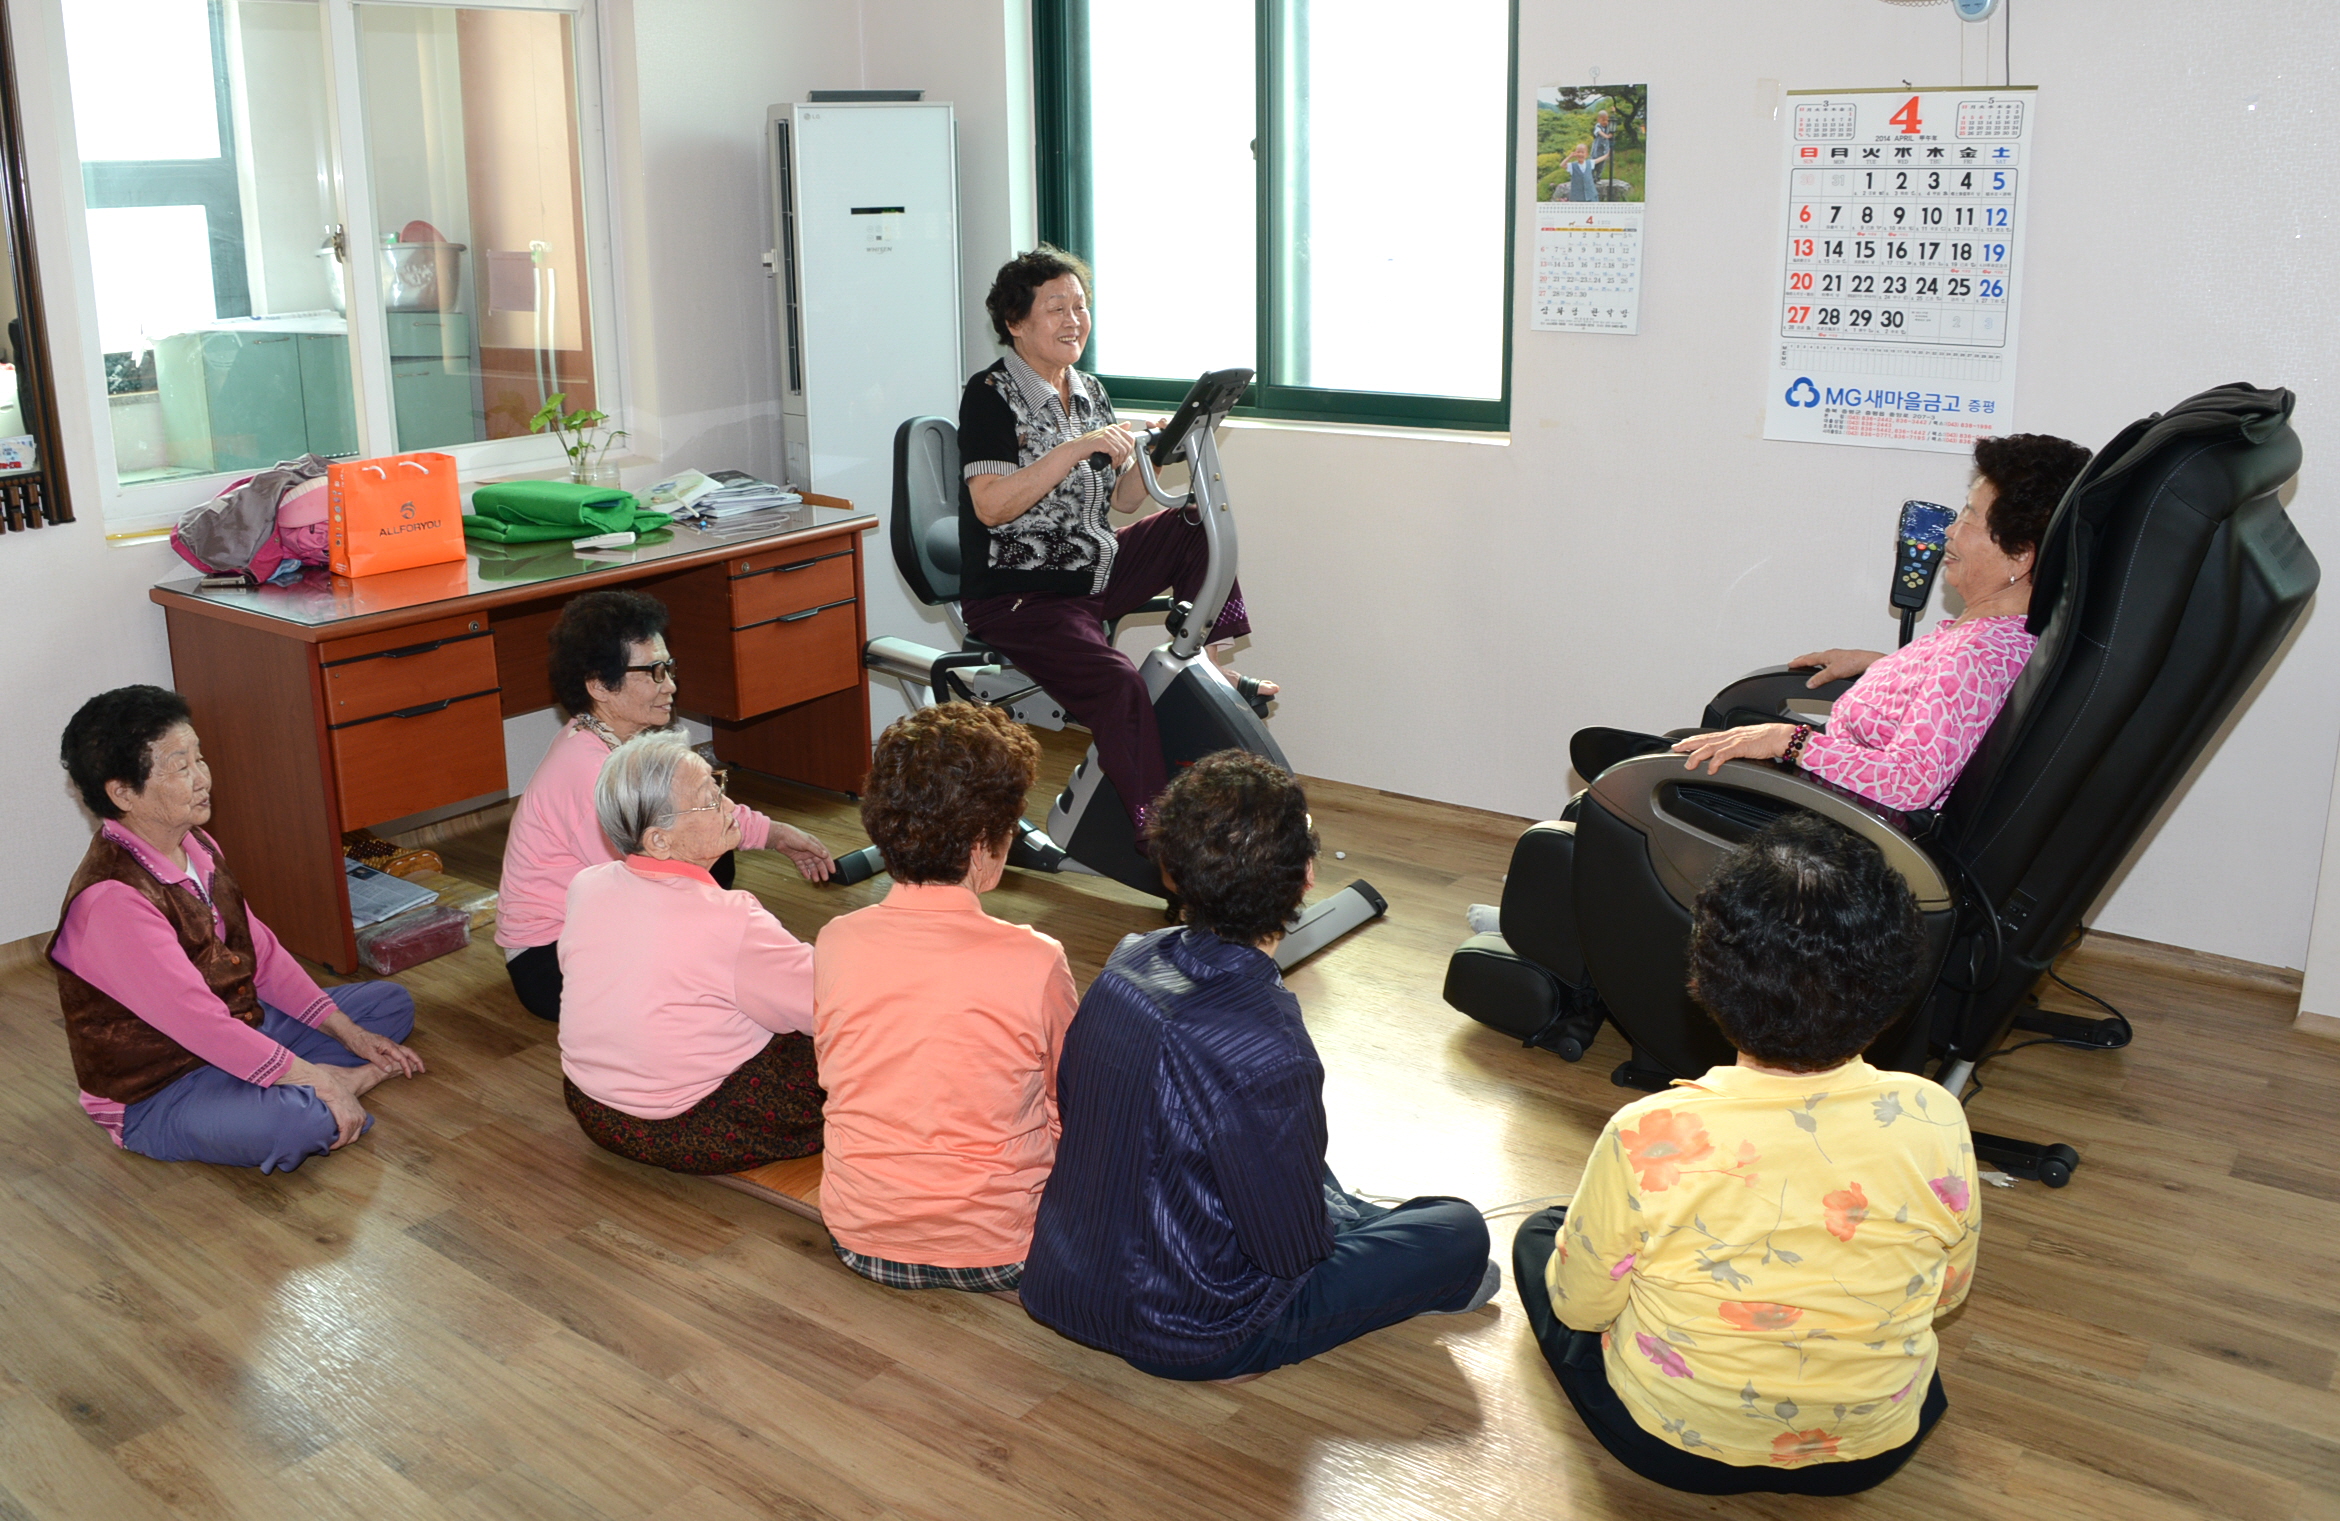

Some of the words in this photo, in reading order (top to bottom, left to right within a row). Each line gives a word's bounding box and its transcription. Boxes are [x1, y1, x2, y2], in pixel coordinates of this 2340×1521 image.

[1889, 96, 1922, 134] 4
[1801, 148, 1818, 158] 日
[1831, 148, 1848, 158] 月
[1863, 148, 1880, 158] 火
[1894, 147, 1912, 158] 水
[1927, 147, 1944, 158] 木
[1960, 147, 1977, 158] 金
[1992, 147, 2010, 158] 土
[1832, 175, 1845, 186] 31
[1866, 172, 1872, 189] 1
[1896, 172, 1907, 189] 2
[1928, 172, 1940, 189] 3
[1961, 172, 1972, 190] 4
[1993, 172, 2005, 190] 5
[1586, 216, 1593, 224] 4
[1800, 205, 1811, 222] 6
[1831, 206, 1842, 223] 7
[1862, 206, 1873, 223] 8
[1894, 207, 1905, 224] 9
[1922, 207, 1942, 225] 10
[1956, 208, 1973, 225] 11
[1986, 208, 2007, 226] 12
[1794, 239, 1813, 256] 13
[1825, 241, 1843, 257] 14
[1856, 241, 1875, 258] 15
[1887, 242, 1907, 259] 16
[1919, 242, 1940, 260] 17
[1952, 243, 1972, 260] 18
[1984, 244, 2005, 262] 19
[1790, 273, 1813, 290] 20
[1822, 274, 1841, 291] 21
[1852, 275, 1874, 292] 22
[1883, 276, 1906, 293] 23
[1916, 277, 1938, 295] 24
[1948, 278, 1970, 296] 25
[1980, 279, 2003, 297] 26
[1788, 306, 1810, 323] 27
[1818, 308, 1840, 325] 28
[1850, 309, 1872, 326] 29
[1881, 310, 1904, 328] 30
[1968, 400, 1995, 414] 증평
[380, 520, 441, 537] ALLFORYOU
